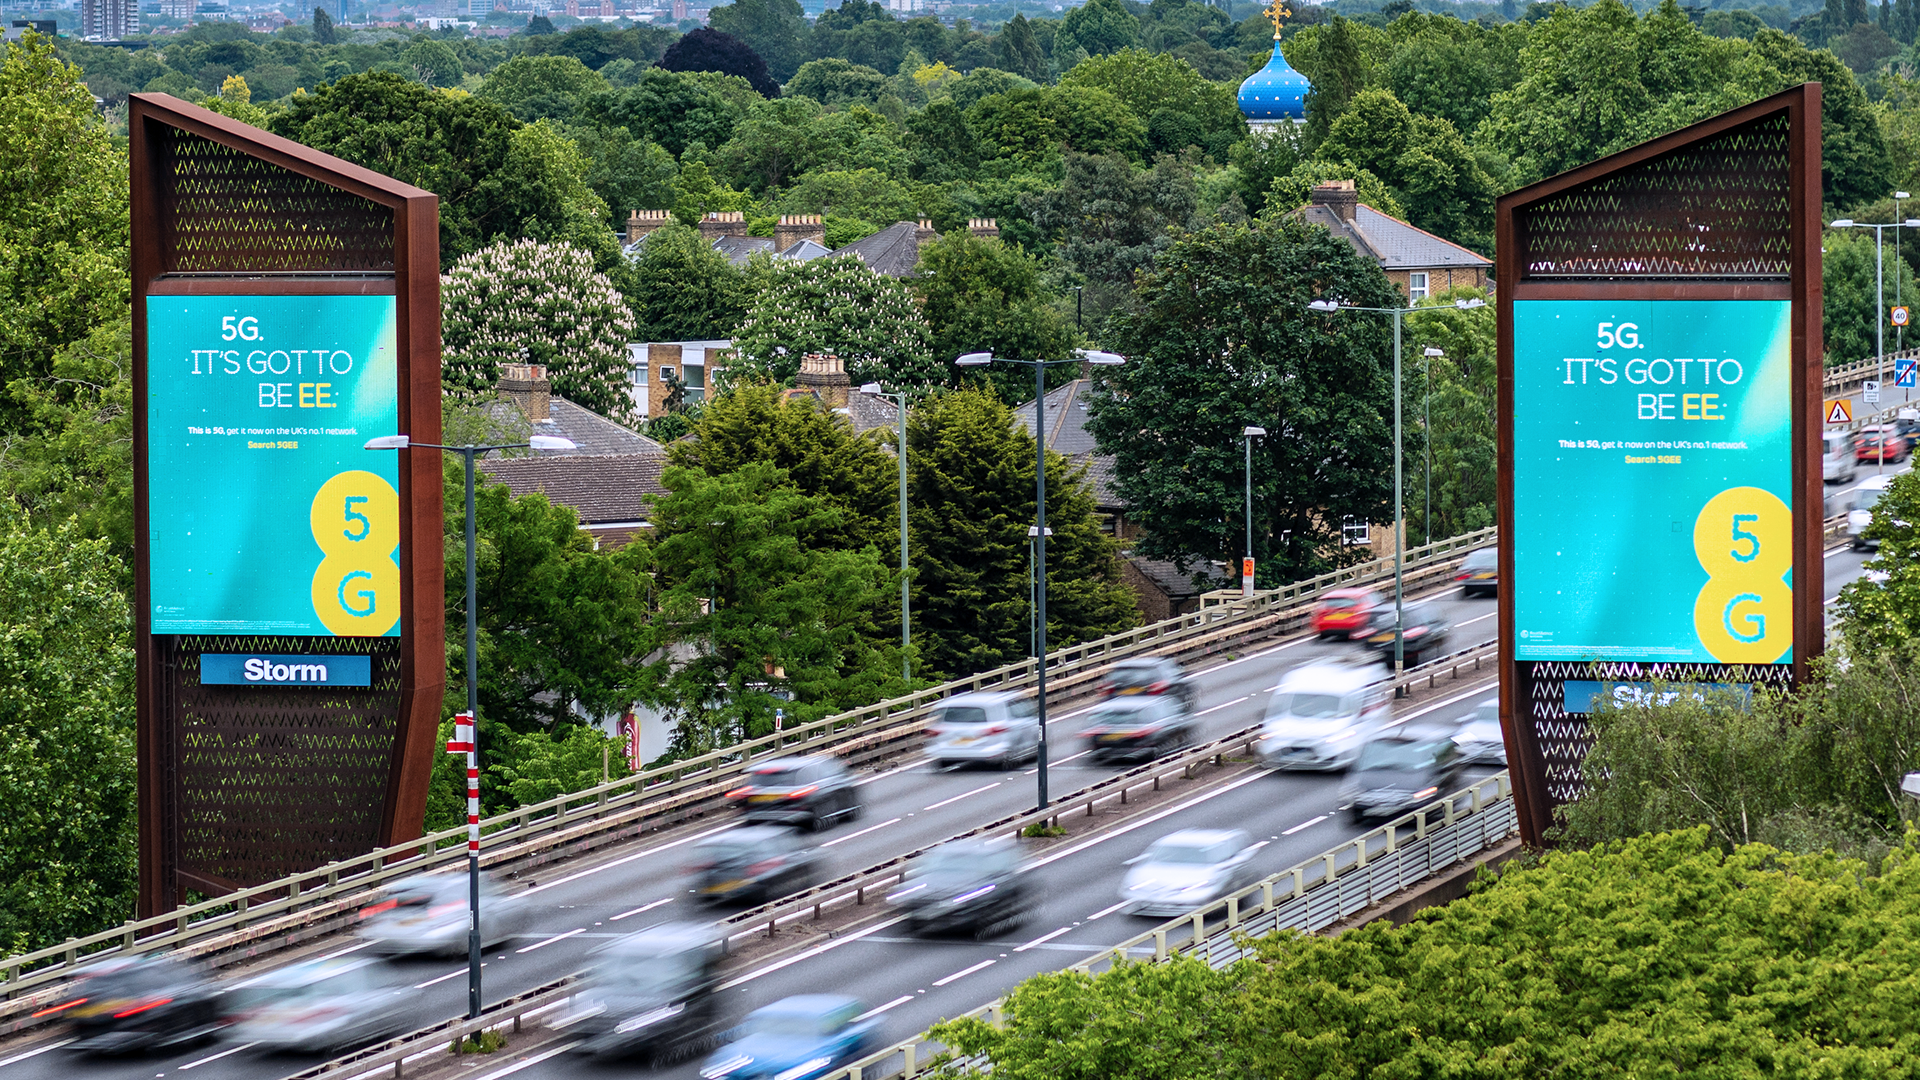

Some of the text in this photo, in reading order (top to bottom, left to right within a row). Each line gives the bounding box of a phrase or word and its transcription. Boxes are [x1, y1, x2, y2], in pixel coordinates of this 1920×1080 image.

[1895, 312, 1905, 320] 40
[222, 316, 264, 341] 5G.
[1597, 322, 1644, 349] 5G.
[247, 350, 308, 374] GOT
[312, 350, 353, 374] TO
[1625, 358, 1694, 384] GOT
[1697, 358, 1743, 384] TO
[259, 383, 337, 407] BE EE.
[1638, 393, 1725, 420] BE EE.
[187, 427, 204, 435] This
[205, 426, 212, 435] is
[226, 428, 239, 436] get
[240, 427, 246, 435] it
[276, 427, 290, 435] the
[325, 427, 358, 435] network.
[247, 440, 298, 449] Search 5GEE
[1558, 440, 1576, 448] This
[1577, 440, 1585, 448] is
[1601, 441, 1616, 450] get
[1617, 440, 1624, 448] it
[1657, 441, 1672, 449] the
[1711, 441, 1748, 449] network.
[1624, 455, 1682, 464] Search 5GEE
[343, 496, 370, 542] 5
[1731, 514, 1760, 563] 5
[337, 570, 376, 618] G
[1723, 593, 1765, 643] G
[244, 658, 327, 682] Storm
